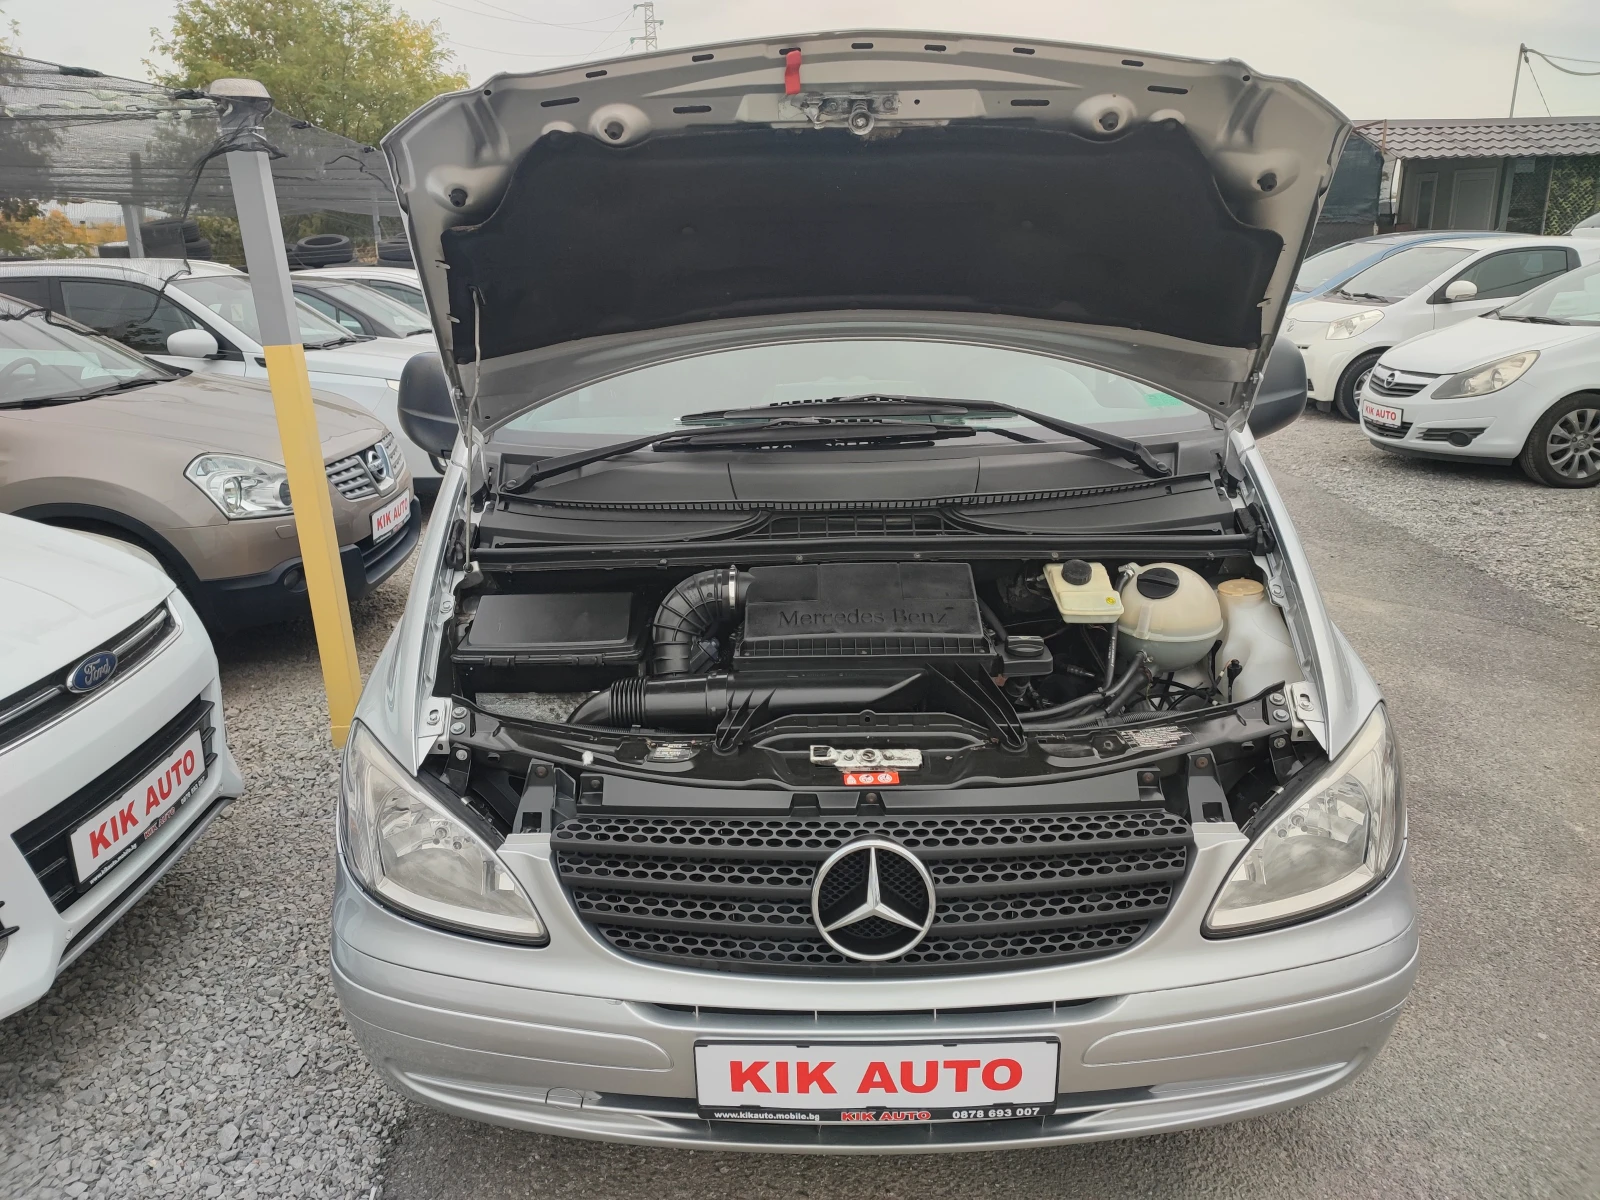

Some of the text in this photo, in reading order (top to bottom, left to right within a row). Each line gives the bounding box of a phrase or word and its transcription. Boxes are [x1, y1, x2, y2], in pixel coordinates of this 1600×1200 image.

[1376, 408, 1397, 421] AUTO
[376, 510, 392, 532] KIK
[393, 498, 409, 521] AUTO
[778, 607, 949, 628] Mercedes Benz
[84, 658, 111, 686] Ford
[89, 750, 196, 859] KIK AUTO
[729, 1058, 1024, 1095] KIK AUTO
[713, 1106, 1041, 1122] www.kikauto.mobile.bg KIK AUTO 0878 693 007
